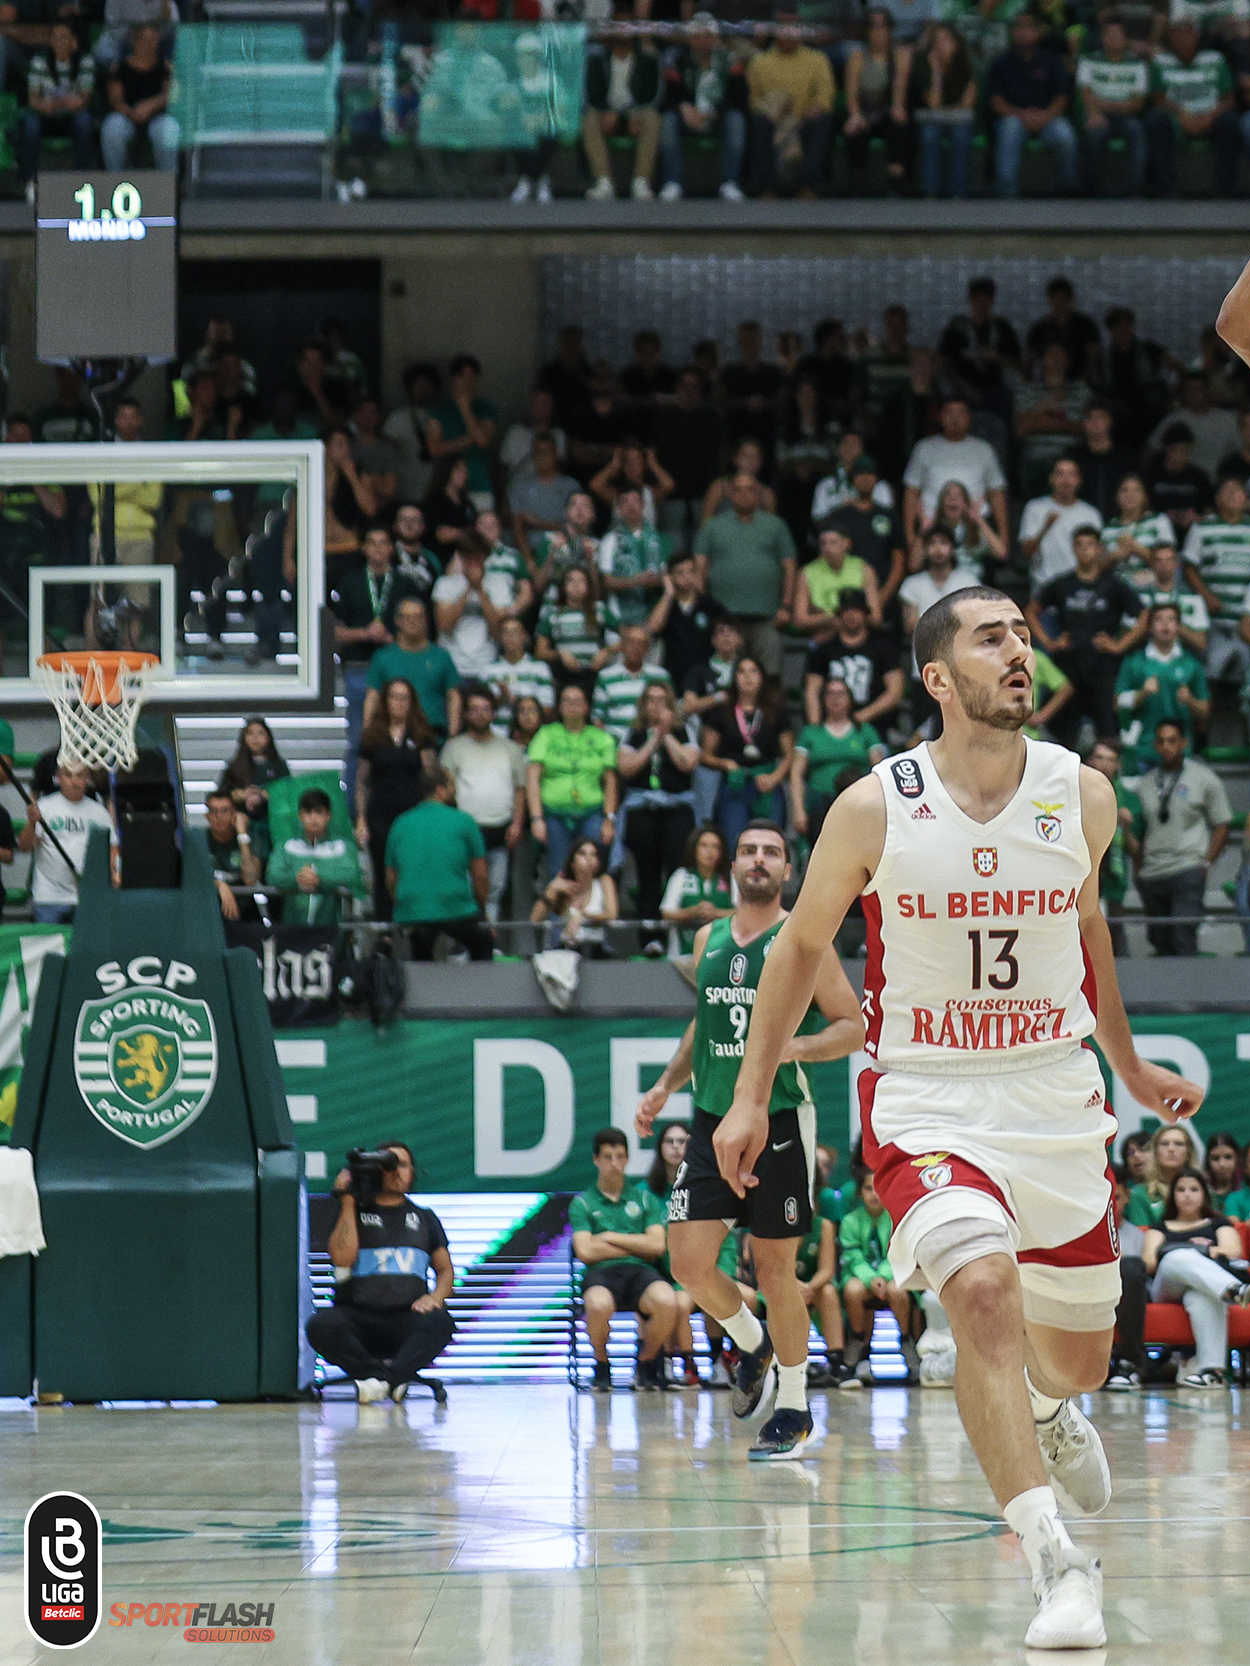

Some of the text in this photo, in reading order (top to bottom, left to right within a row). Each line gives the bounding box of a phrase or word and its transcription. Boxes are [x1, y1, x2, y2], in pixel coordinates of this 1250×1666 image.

[74, 182, 143, 220] 1.0
[897, 887, 1076, 919] SL BENFICA
[95, 955, 198, 996] SCP
[257, 936, 333, 1001] las
[968, 929, 1019, 990] 13
[705, 986, 757, 1005] SPORTIN
[945, 998, 1053, 1012] conservas
[89, 999, 202, 1039] SPORTING
[729, 1004, 748, 1039] 9
[911, 1007, 1073, 1051] RAMIREZ
[96, 1097, 198, 1128] PORTUGAL
[373, 1248, 415, 1274] TV
